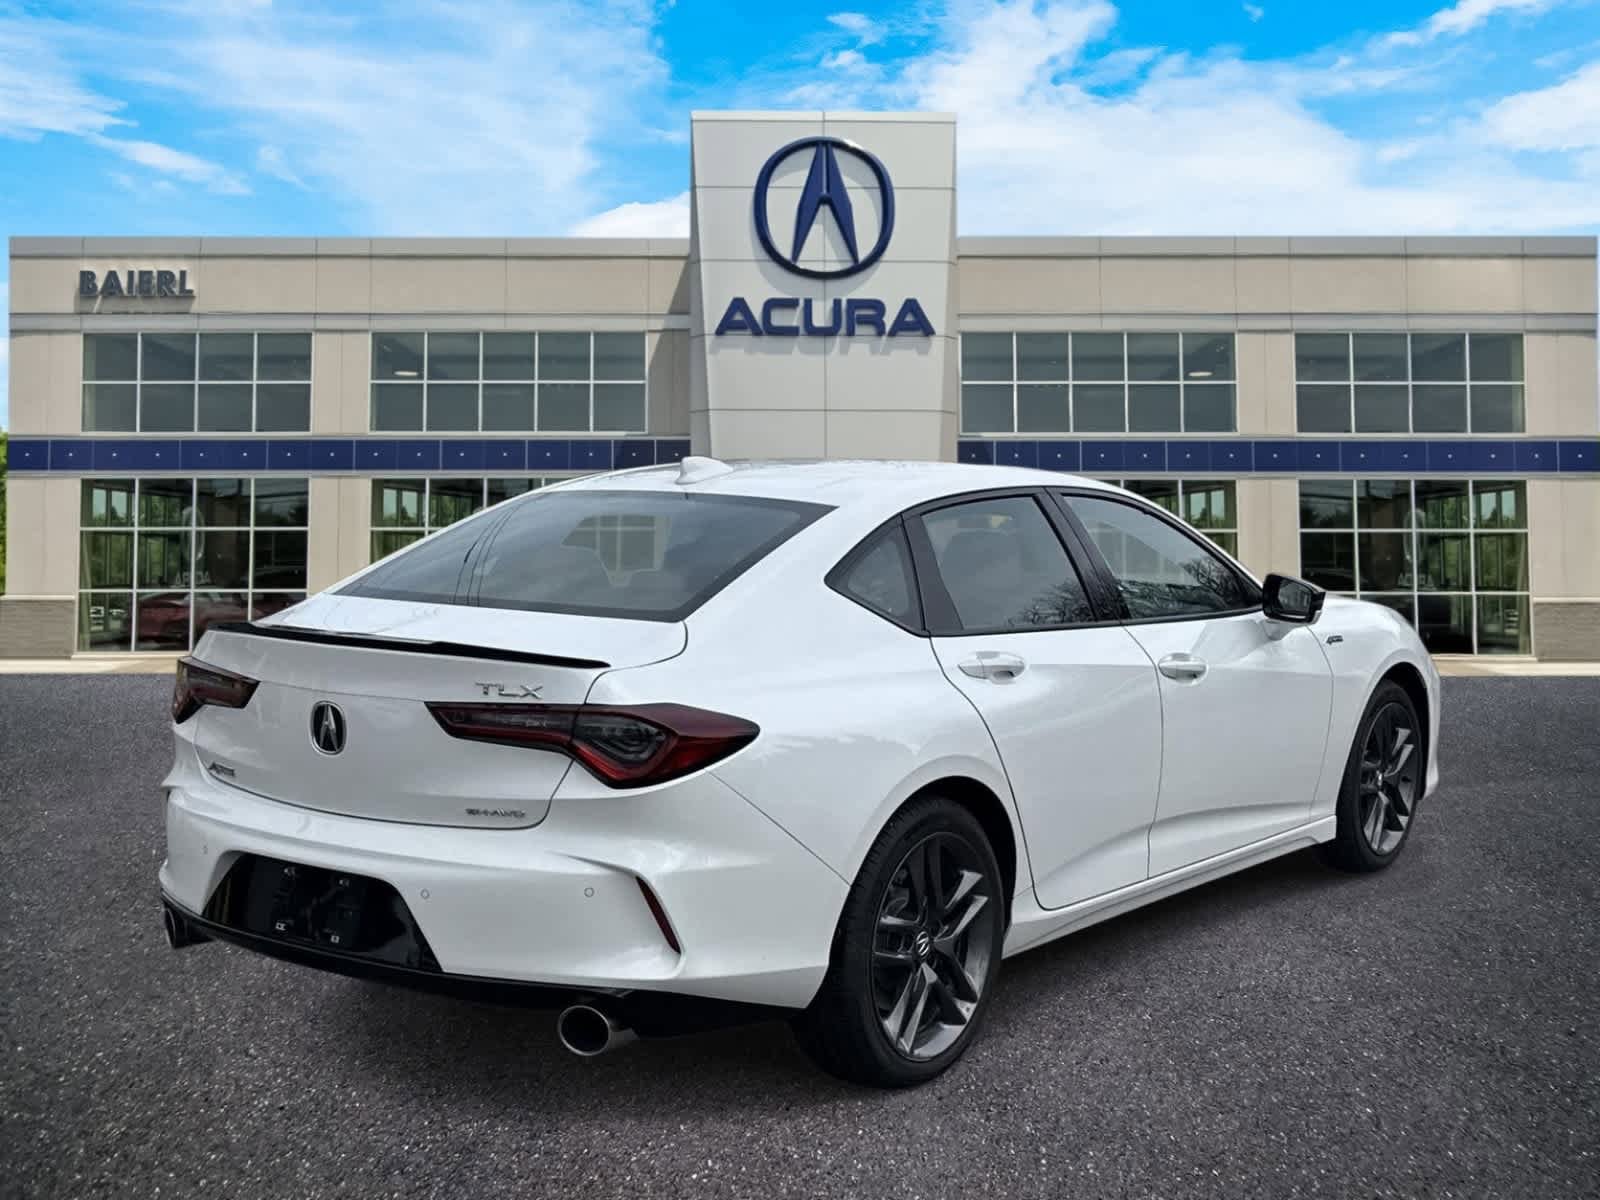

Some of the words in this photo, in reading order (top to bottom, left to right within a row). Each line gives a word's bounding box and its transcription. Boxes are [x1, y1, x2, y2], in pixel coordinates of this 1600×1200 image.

[79, 270, 194, 296] BAIERL
[715, 297, 936, 337] ACURA
[475, 682, 543, 700] TLX
